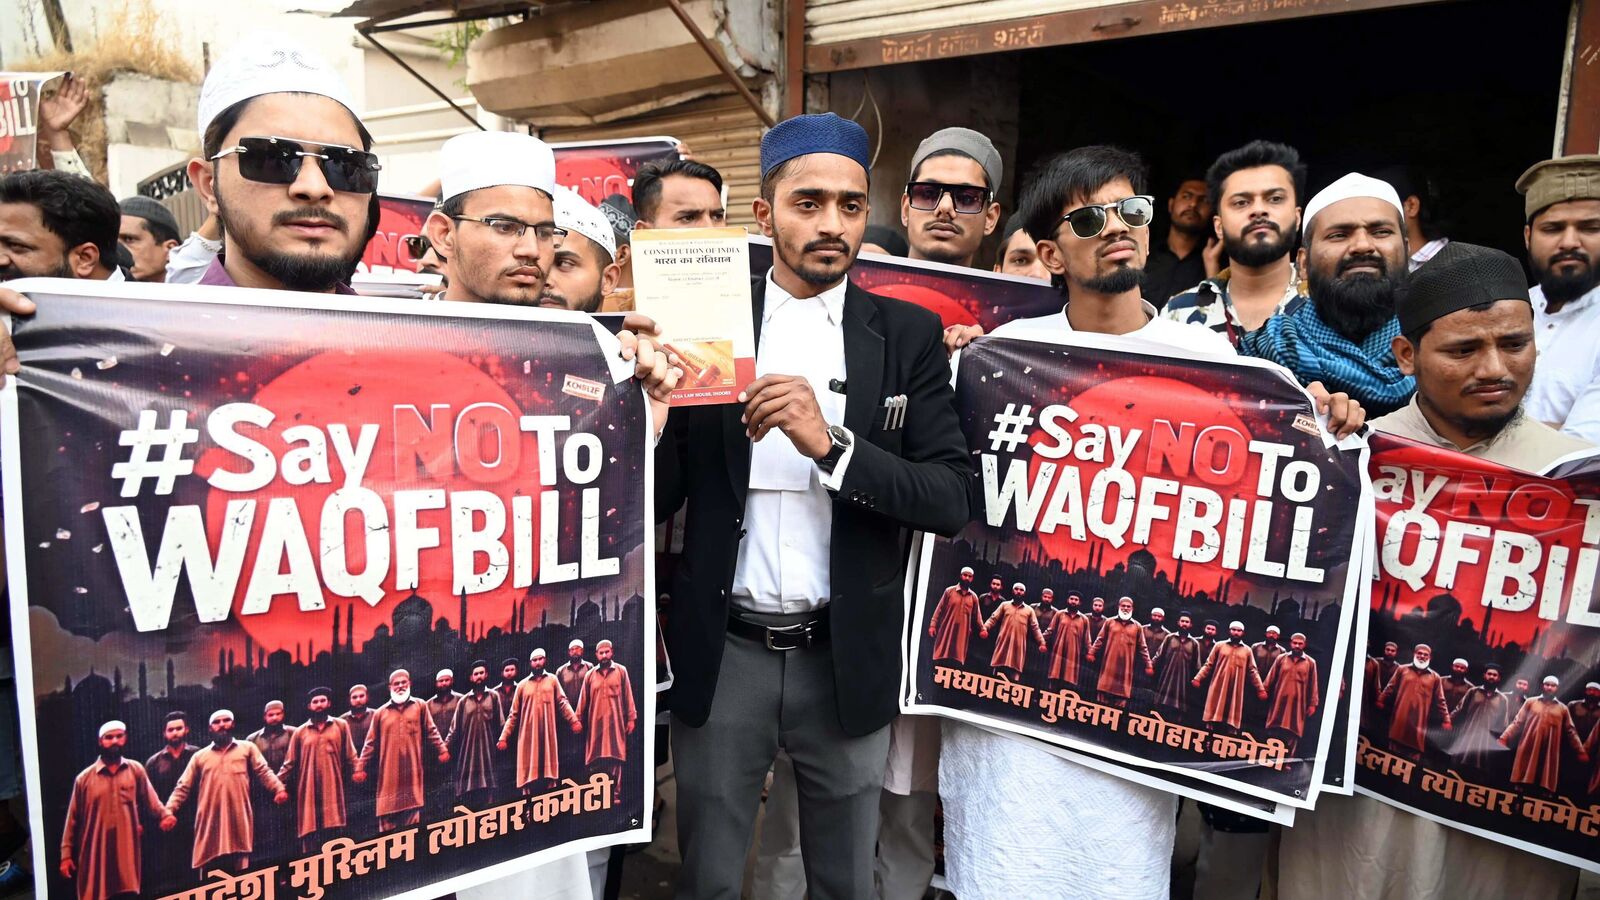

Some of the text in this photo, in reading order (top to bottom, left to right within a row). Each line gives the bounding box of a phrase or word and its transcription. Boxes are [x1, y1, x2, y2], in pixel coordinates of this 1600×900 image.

[644, 247, 703, 256] CONSTITUTION
[716, 246, 740, 254] INDIA
[654, 253, 731, 265] भारत का संविधान
[111, 402, 603, 498] #Say NO To
[988, 403, 1321, 502] #Say NO To
[1372, 465, 1600, 545] ay NO T
[934, 665, 1288, 771] मध्यप्रदेश मुस्लिम त्योहार कमेटी
[1421, 768, 1517, 815] त्योहार
[289, 828, 418, 900] मुस्लिम
[427, 805, 527, 855] त्योहार
[531, 772, 614, 824] कमेटी
